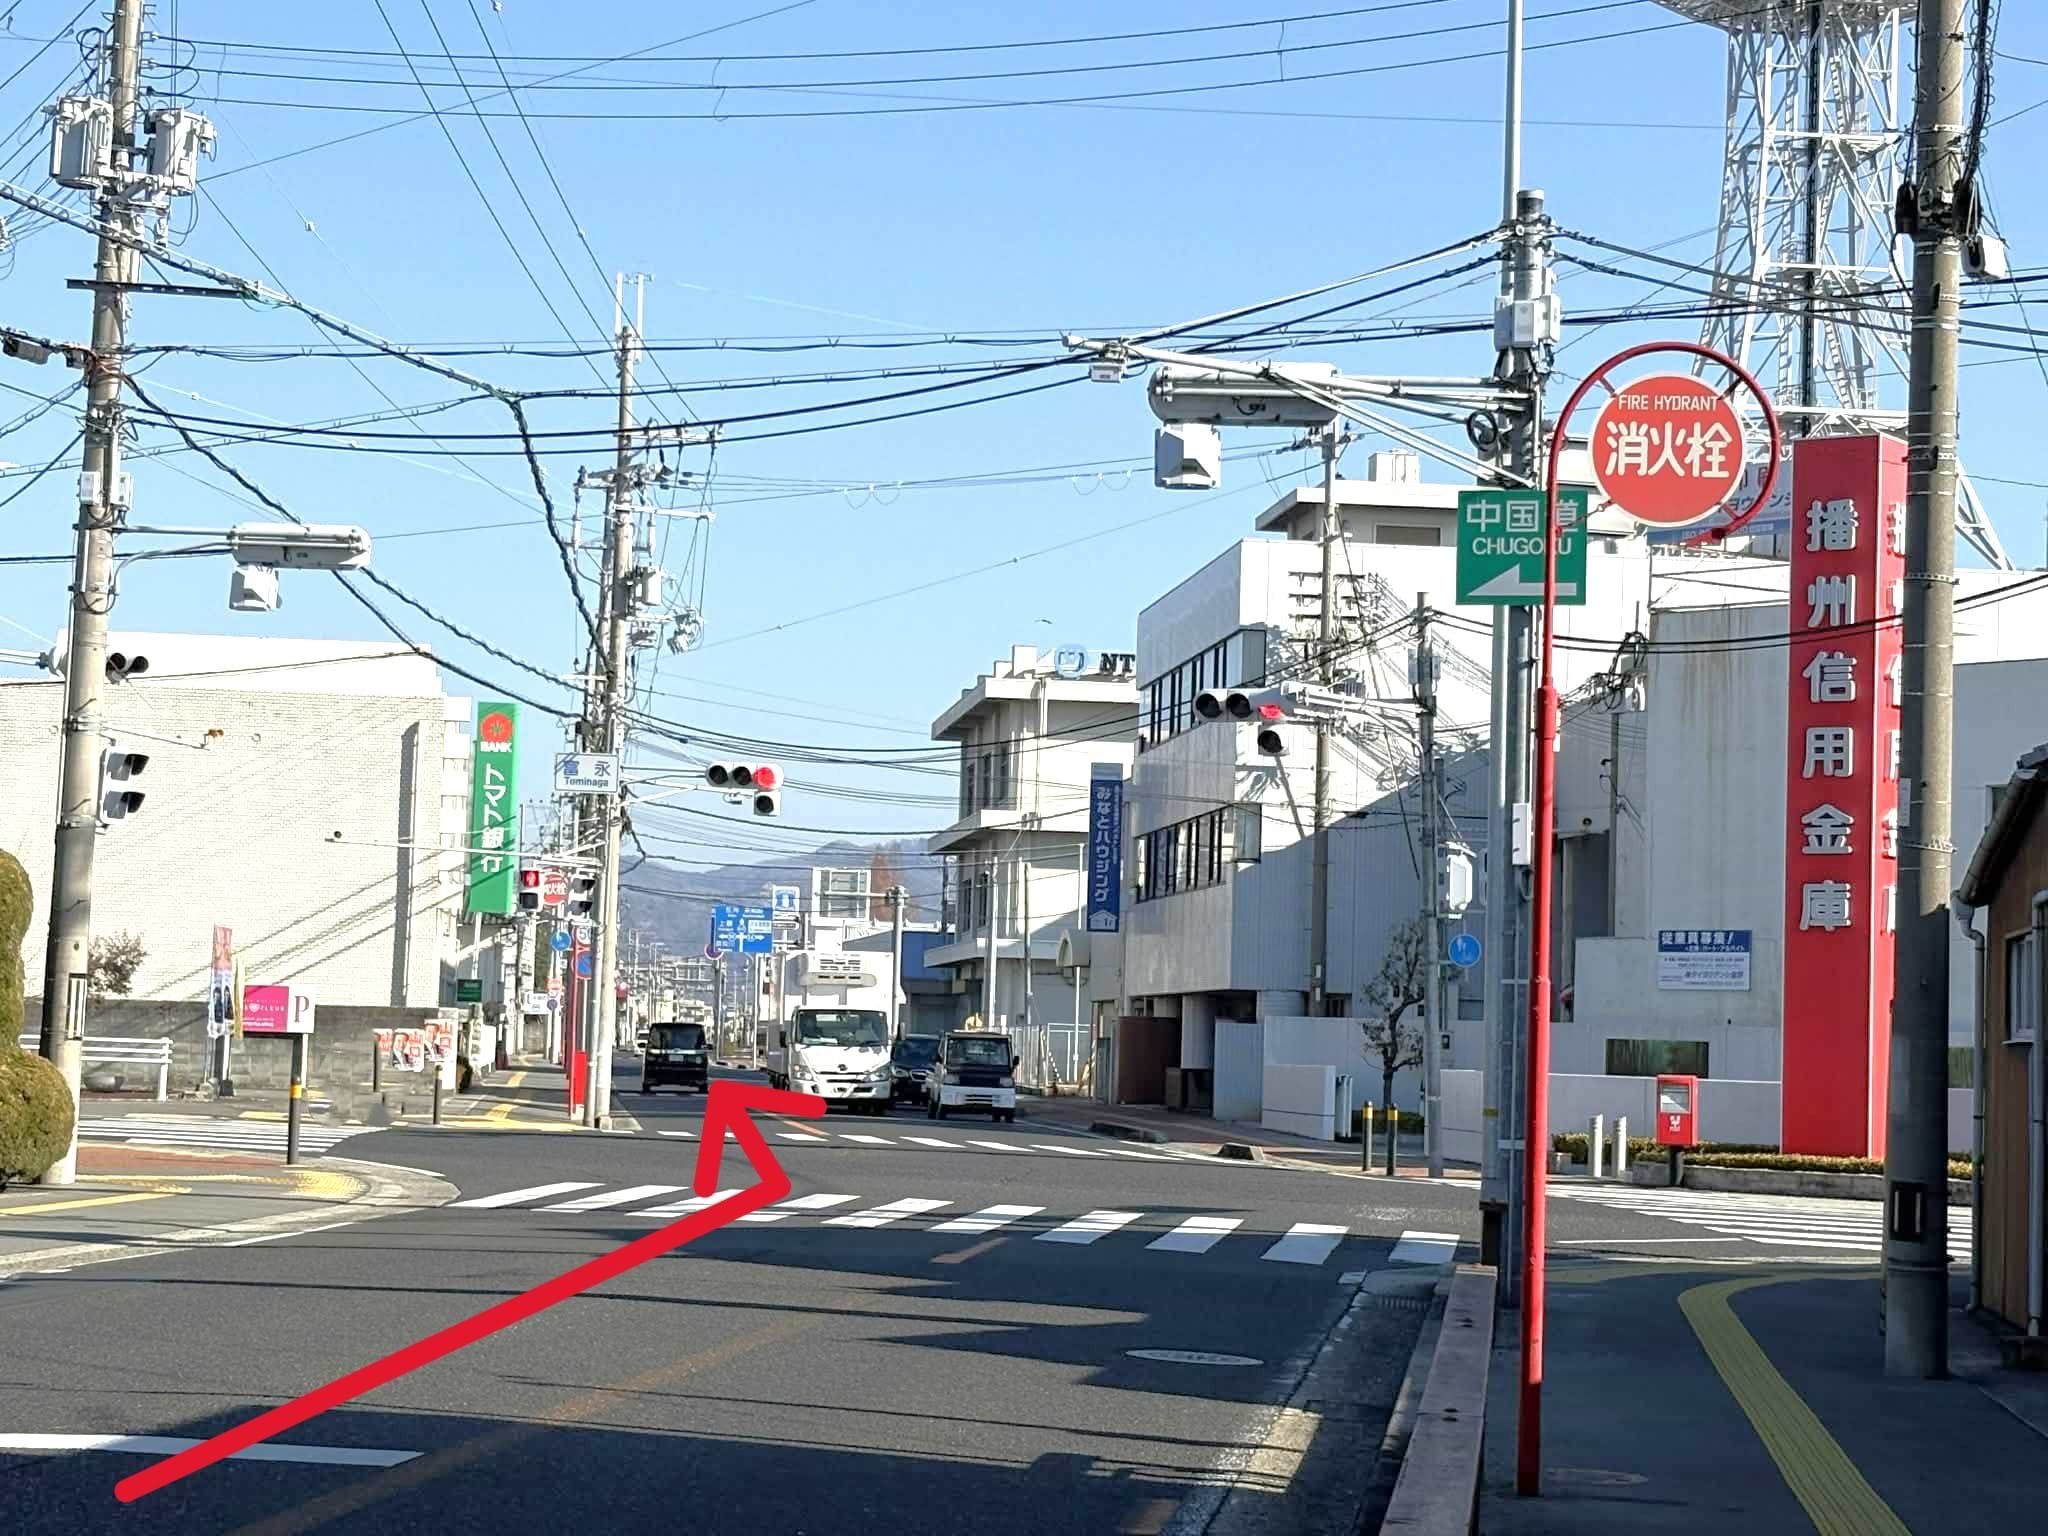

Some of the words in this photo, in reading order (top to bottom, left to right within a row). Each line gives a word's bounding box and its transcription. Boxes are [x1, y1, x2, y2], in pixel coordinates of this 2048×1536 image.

[1618, 395, 1648, 410] FIRE
[1654, 395, 1719, 411] HYDRANT
[1605, 421, 1733, 478] 消火栓
[1472, 537, 1572, 555] CHUGOU
[1800, 498, 1858, 932] 播州信用金庫
[480, 741, 512, 753] BANK
[563, 761, 611, 777] 富永
[564, 776, 609, 787] Tominaga
[480, 763, 507, 873] トマト銀行
[1095, 786, 1112, 902] みなとハウジング
[294, 995, 310, 1023] P
